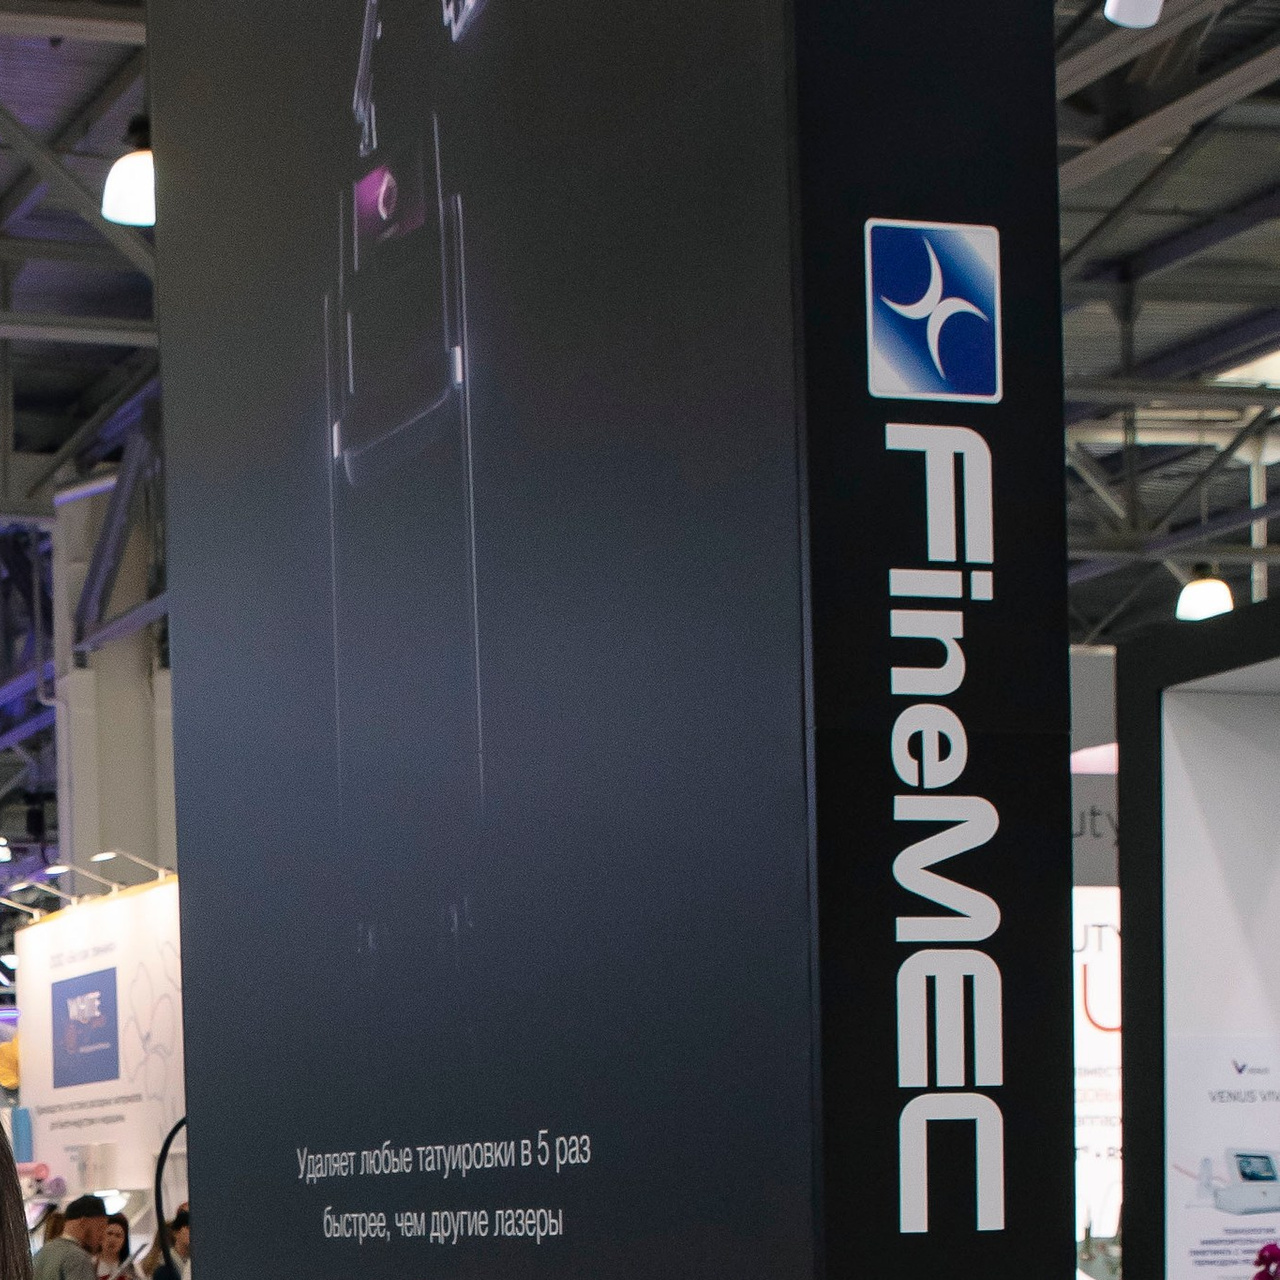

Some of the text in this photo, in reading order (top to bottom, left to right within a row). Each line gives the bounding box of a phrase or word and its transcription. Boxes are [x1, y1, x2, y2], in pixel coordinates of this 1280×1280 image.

[885, 422, 1005, 1234] FineMEC
[296, 1129, 591, 1184] Удаляет любые татуировки в 5 раз
[323, 1206, 564, 1245] быстрее, чем другие лазеры
